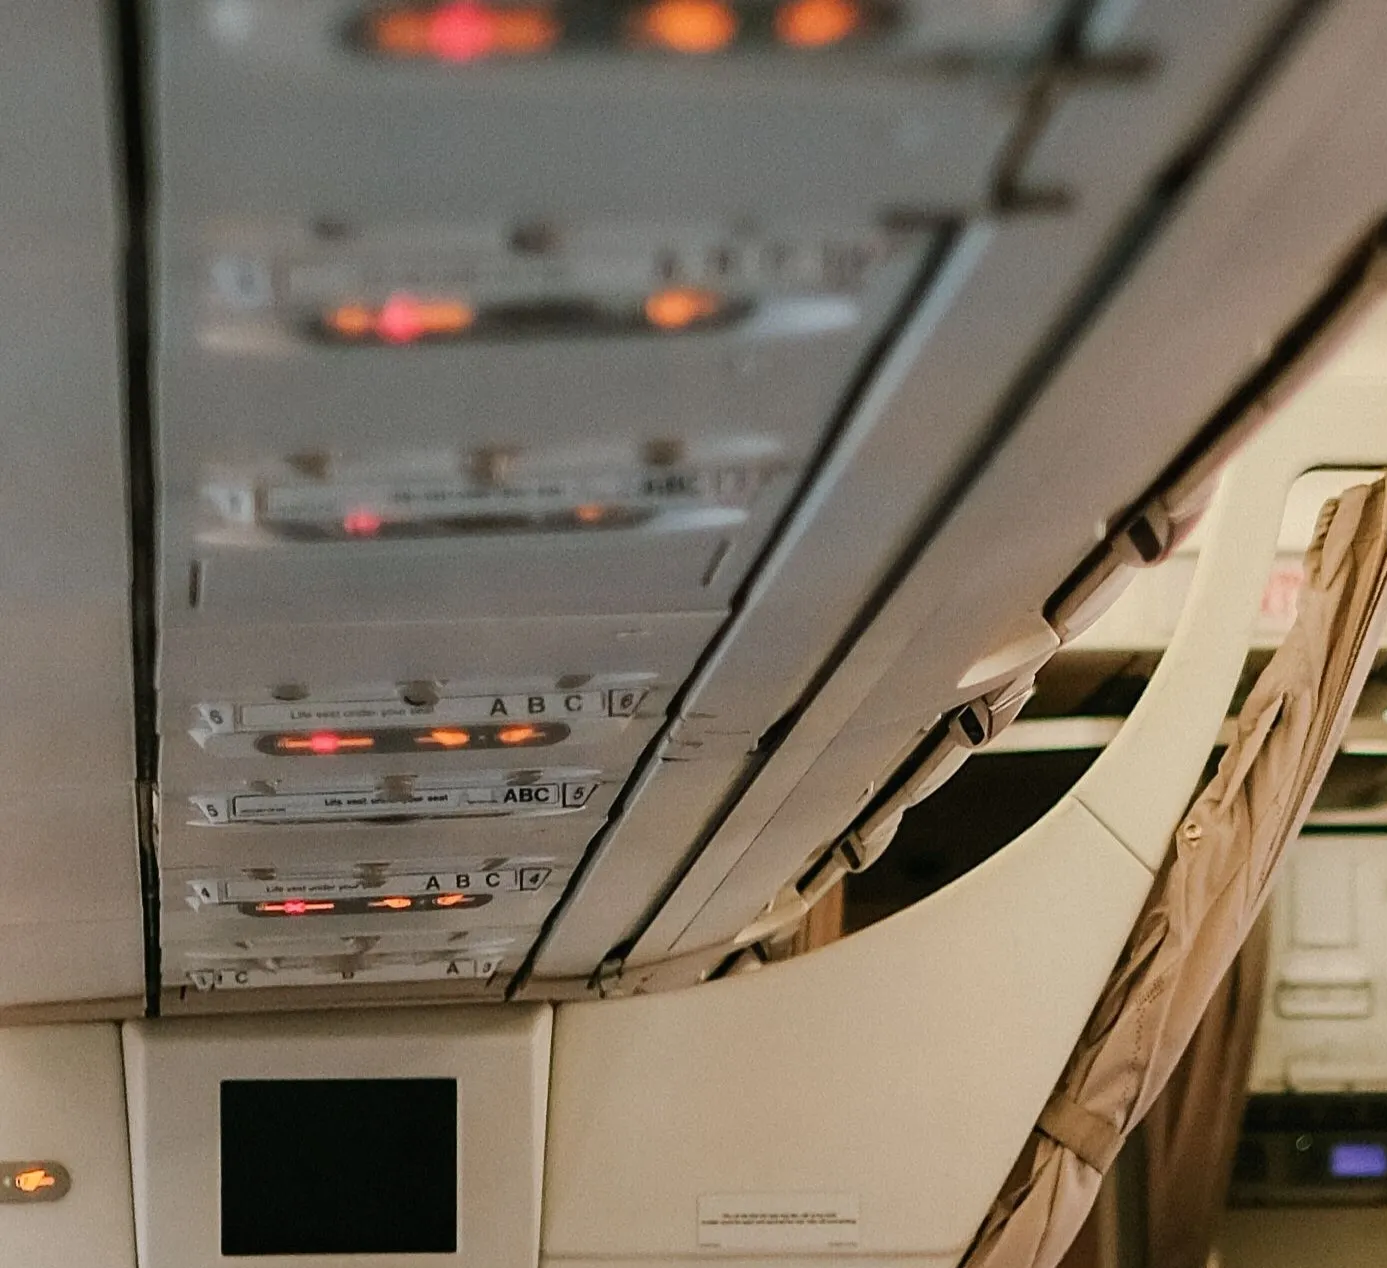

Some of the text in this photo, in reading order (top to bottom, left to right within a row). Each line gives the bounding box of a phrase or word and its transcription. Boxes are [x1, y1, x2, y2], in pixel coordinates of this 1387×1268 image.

[490, 694, 582, 716] A B C
[504, 787, 550, 803] ABC
[425, 872, 500, 891] A B C
